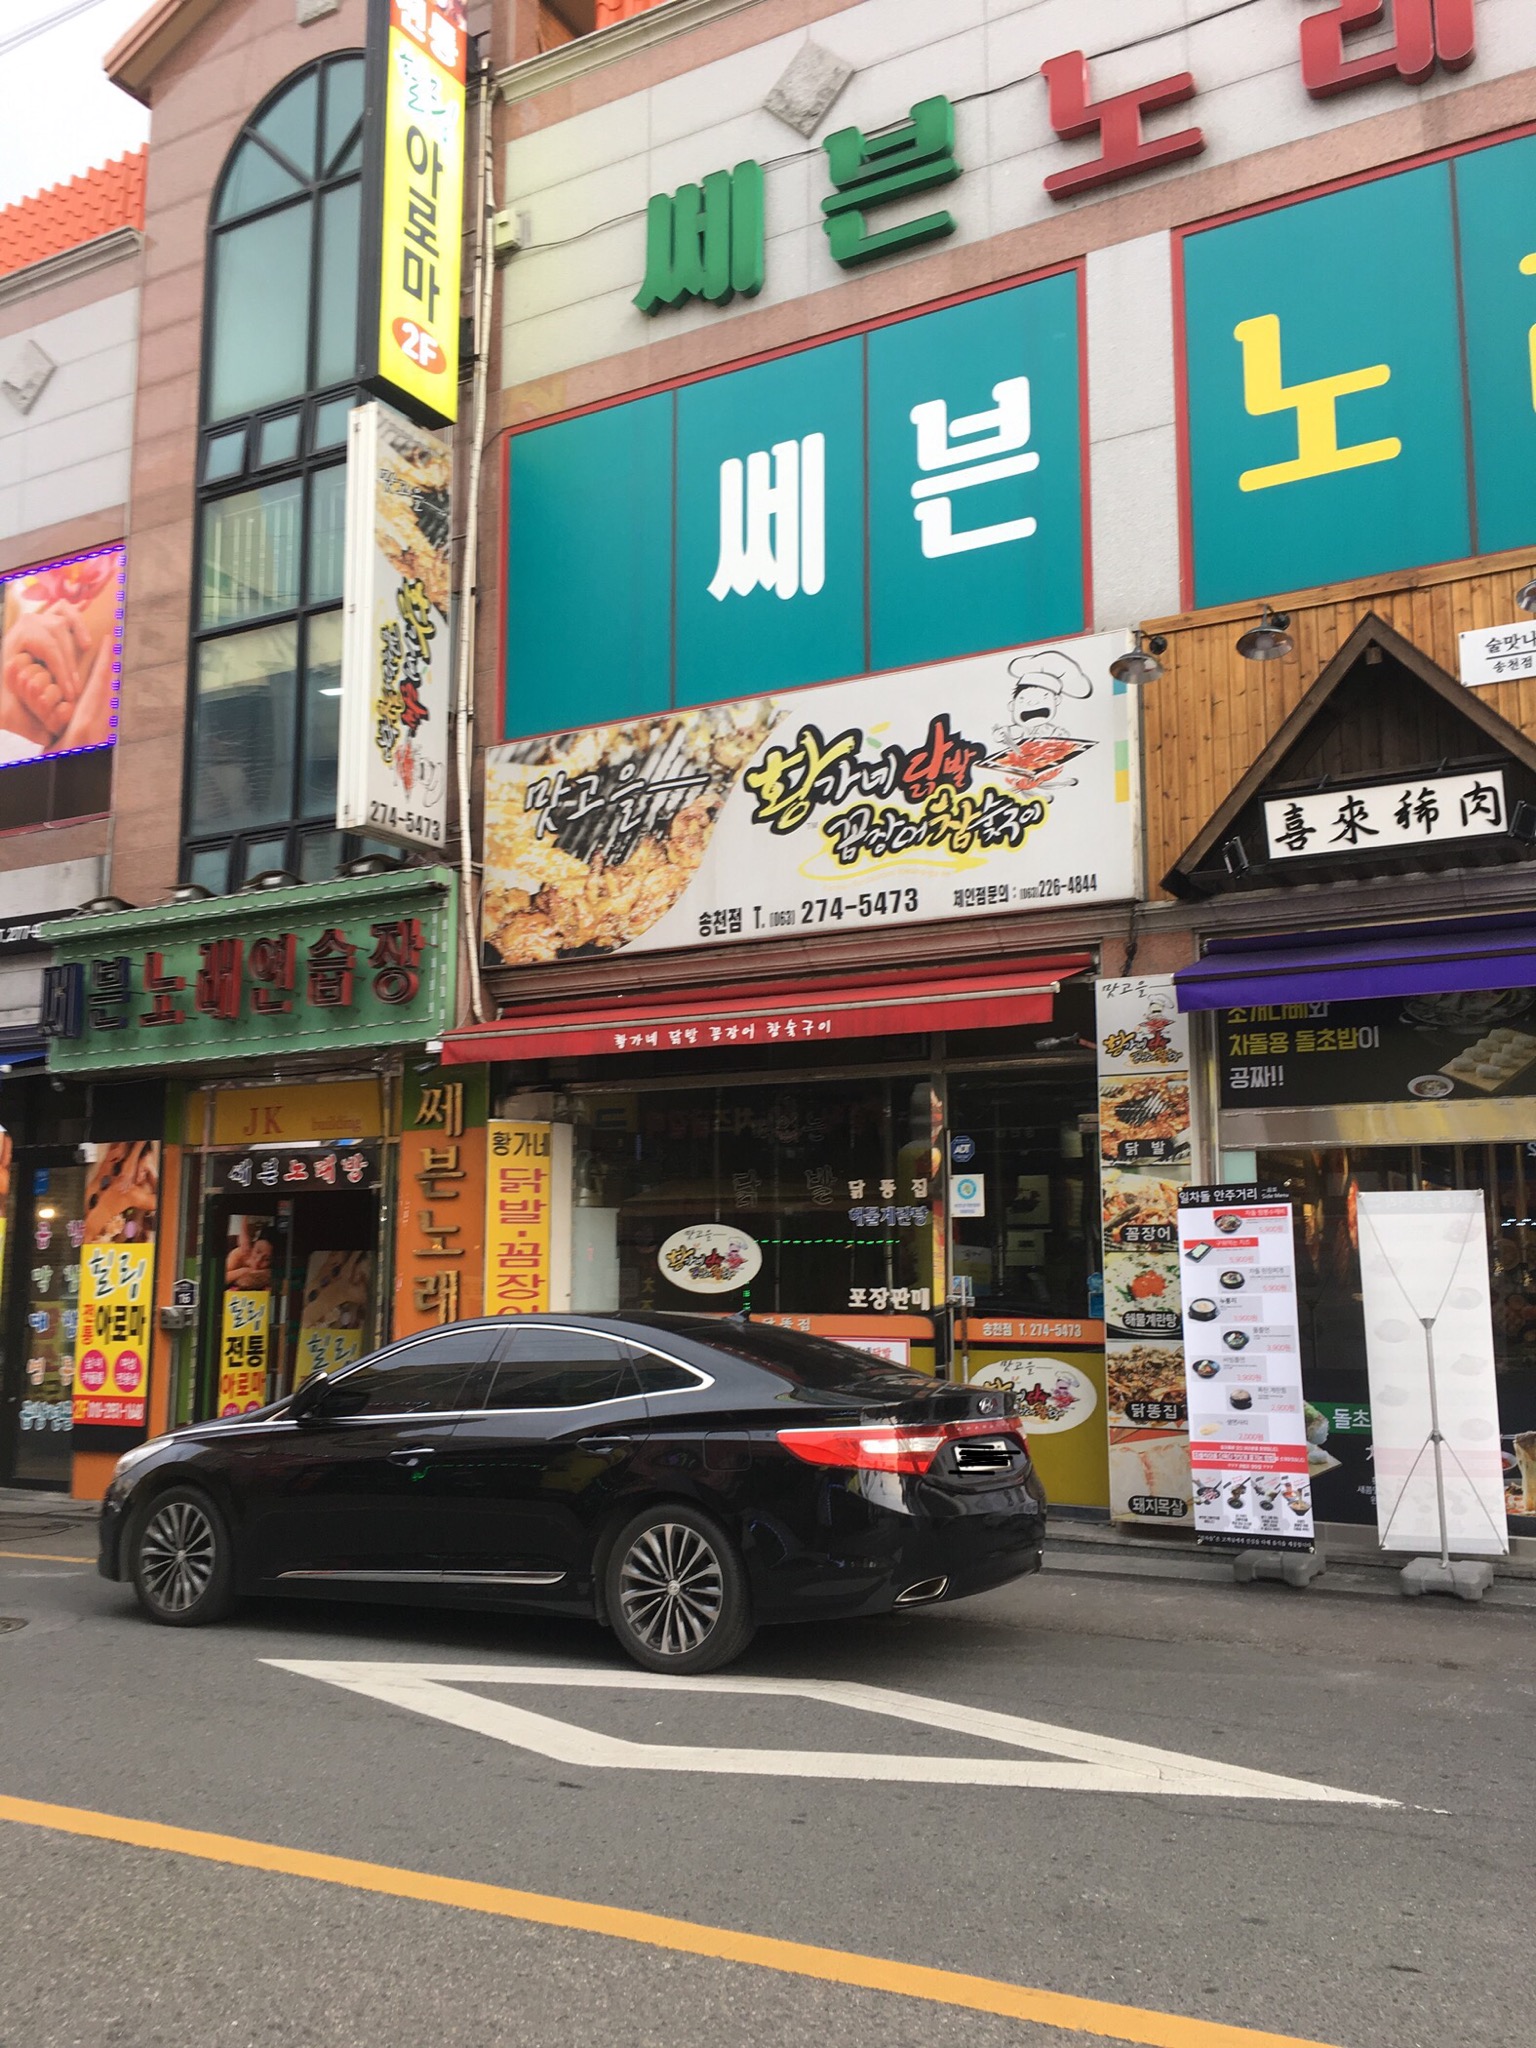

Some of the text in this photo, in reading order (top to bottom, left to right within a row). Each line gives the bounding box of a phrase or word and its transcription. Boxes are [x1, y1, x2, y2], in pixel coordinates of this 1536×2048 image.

[403, 125, 444, 324] 아로마
[401, 321, 438, 366] 2F
[1492, 655, 1533, 674] 송천점
[744, 712, 988, 836] 황가네 닭발
[524, 762, 646, 841] 맛고을
[369, 800, 442, 841] 274-5473
[698, 907, 742, 937] 송천점
[753, 906, 766, 929] T.
[801, 887, 919, 924] 274-5473
[1102, 980, 1148, 999] 맛고을
[615, 1033, 658, 1049] 황가네
[1229, 1025, 1380, 1056] 차돌용 돌초밥이
[1229, 1064, 1285, 1089] 공짜!!
[243, 1105, 285, 1136] JK
[491, 1131, 550, 1157] 황가네
[414, 1082, 468, 1325] 쎄븐노래
[1178, 1191, 1211, 1205] 일차돌
[1213, 1187, 1258, 1202] 안주거리
[1124, 1226, 1171, 1242] 꼼장어
[847, 1286, 931, 1311] 포장판매
[95, 1304, 146, 1346] 아로마
[982, 1322, 1013, 1337] 송천점
[1029, 1322, 1082, 1338] 274-5473
[1124, 1312, 1178, 1329] 해물계란탕
[225, 1334, 266, 1368] 전통
[220, 1371, 266, 1399] 아로마
[1132, 1496, 1184, 1516] 돼지목살
